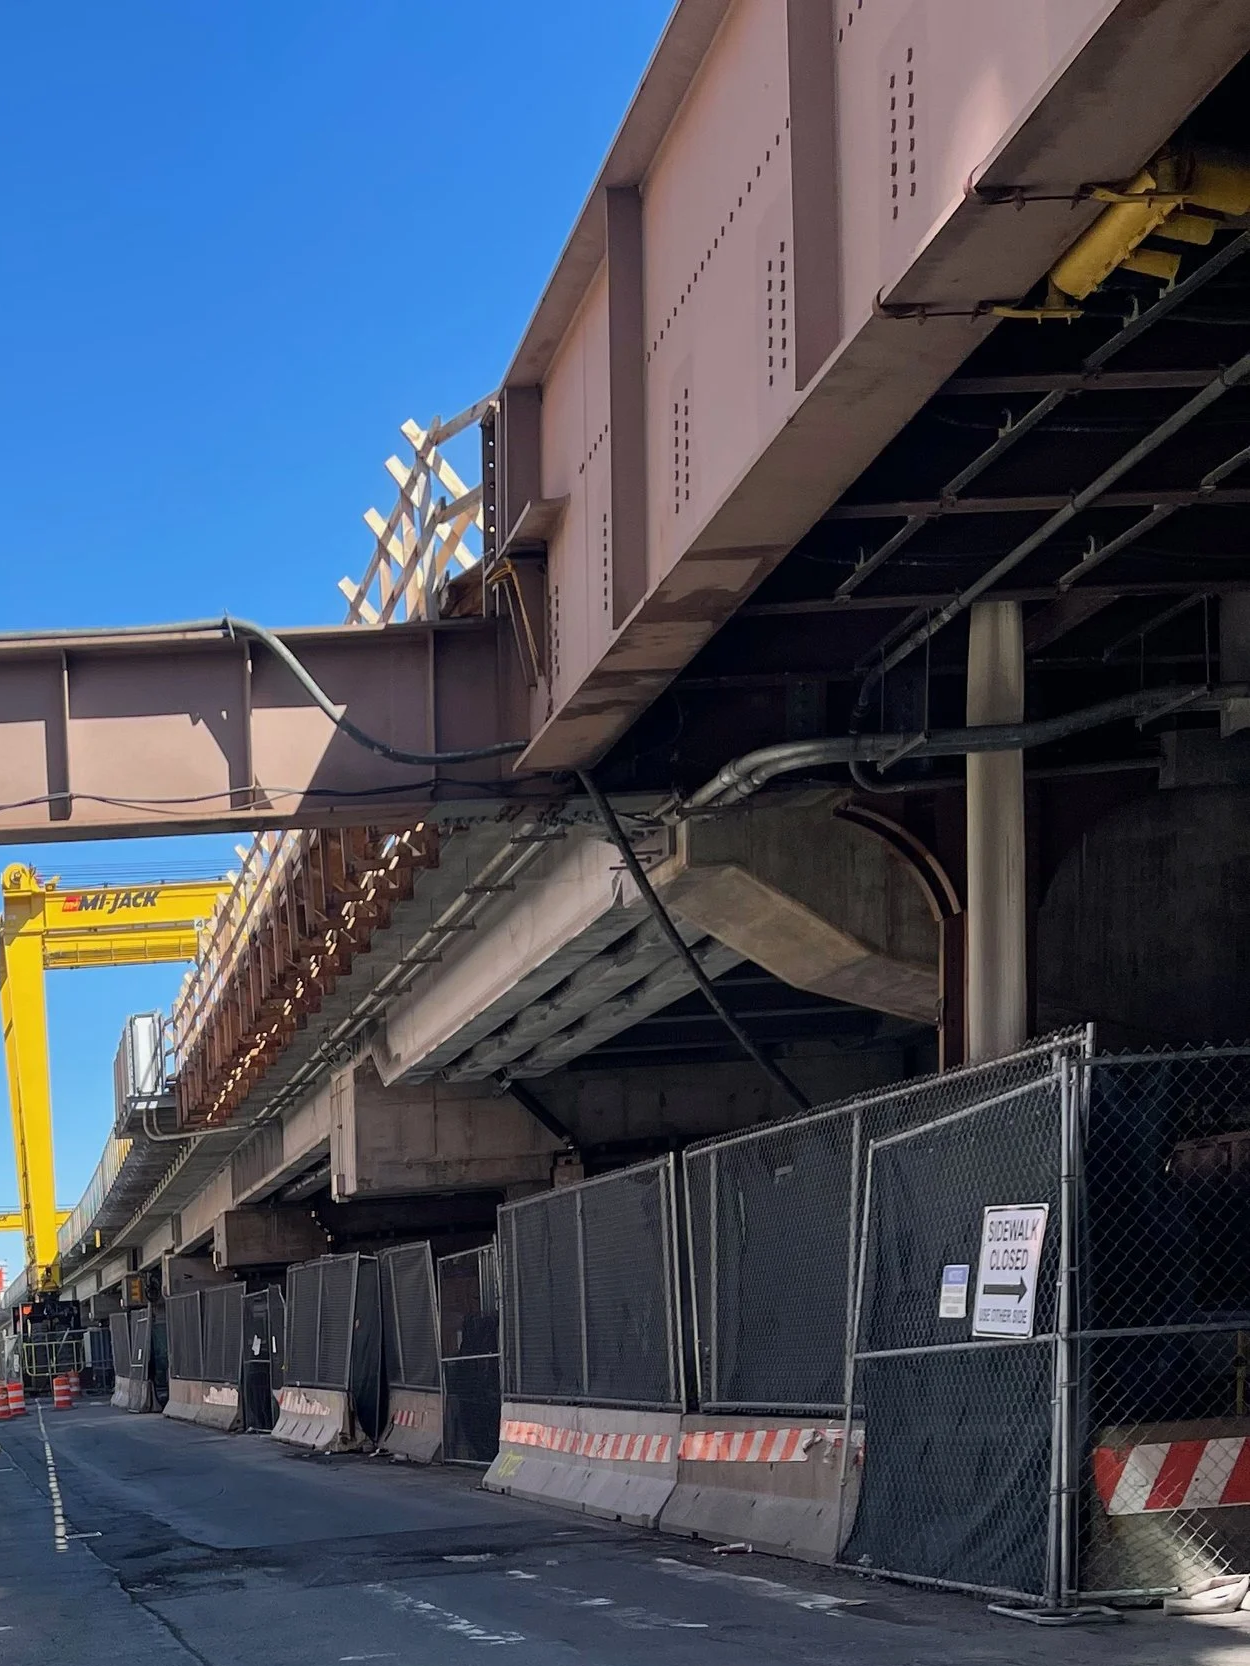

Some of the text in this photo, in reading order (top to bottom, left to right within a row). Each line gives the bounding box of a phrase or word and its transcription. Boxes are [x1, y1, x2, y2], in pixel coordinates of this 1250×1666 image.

[78, 890, 161, 914] MI-JACK
[988, 1218, 1040, 1242] SIDEWALK
[990, 1248, 1029, 1270] CLOSED
